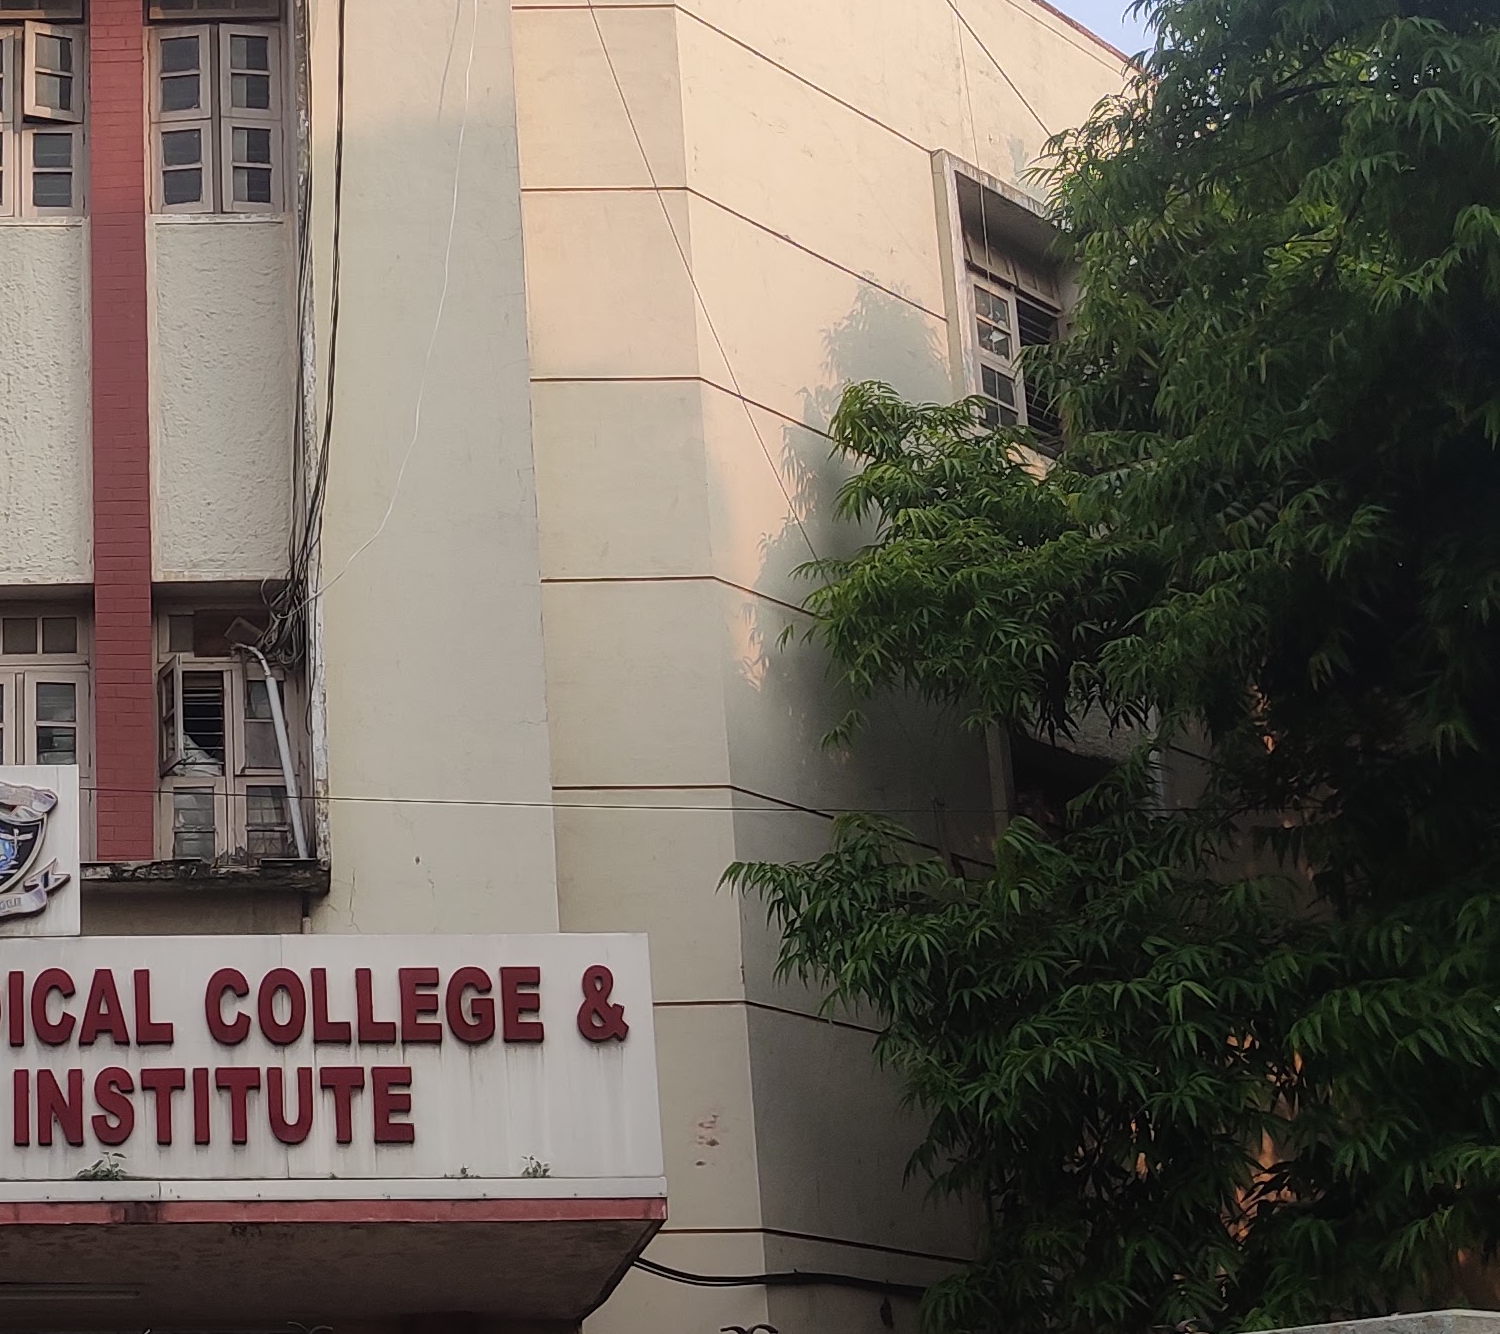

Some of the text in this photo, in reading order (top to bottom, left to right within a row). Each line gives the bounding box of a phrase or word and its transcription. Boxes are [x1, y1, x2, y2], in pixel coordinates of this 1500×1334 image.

[204, 965, 546, 1045] COLLEGE
[576, 963, 630, 1042] &
[12, 1066, 417, 1146] INSTITUTE
